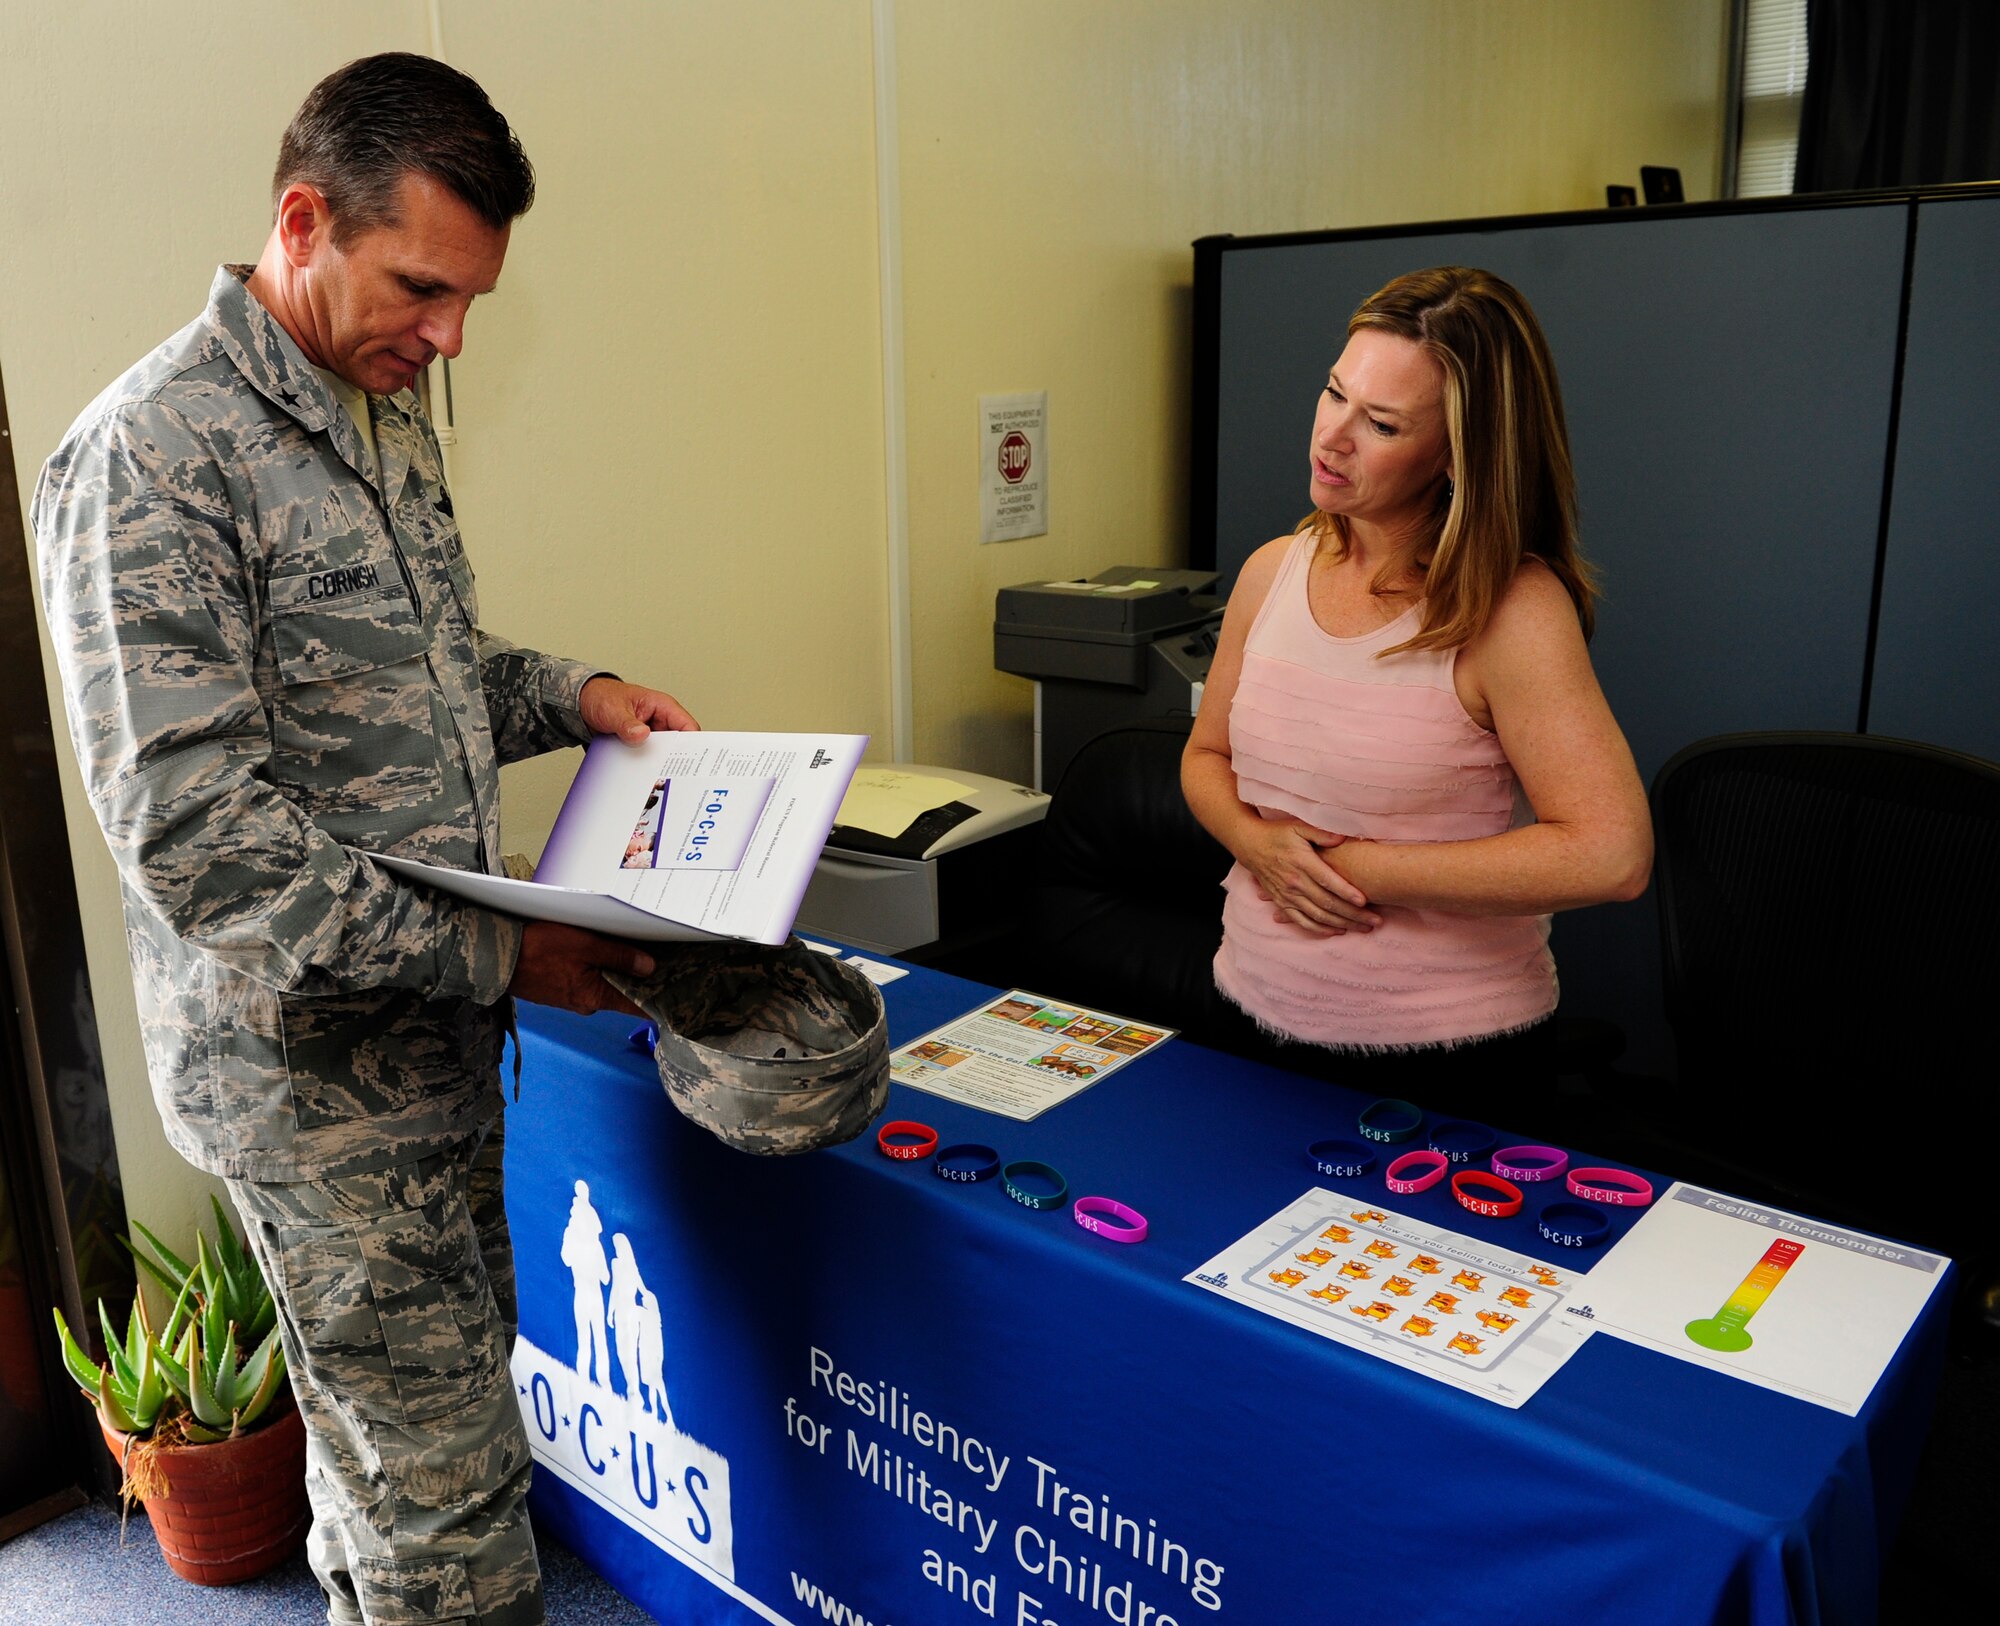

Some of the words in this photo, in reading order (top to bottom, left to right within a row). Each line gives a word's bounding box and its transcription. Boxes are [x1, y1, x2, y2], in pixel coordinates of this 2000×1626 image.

[990, 424, 1004, 433] NOT
[1002, 445, 1027, 469] STOP
[308, 564, 380, 600] CORNISH
[1377, 1223, 1401, 1234] How
[1403, 1233, 1421, 1242] are
[1423, 1240, 1444, 1250] you
[1446, 1246, 1485, 1264] feeling
[1487, 1260, 1526, 1276] today?
[1704, 1198, 1771, 1224] Feeling
[1777, 1218, 1906, 1262] Thermometer
[1780, 1242, 1798, 1251] 100
[784, 1397, 831, 1456] for
[846, 1429, 998, 1554] Military
[808, 1345, 1011, 1492] Resiliency
[1026, 1455, 1226, 1612] Training
[922, 1549, 996, 1618] and
